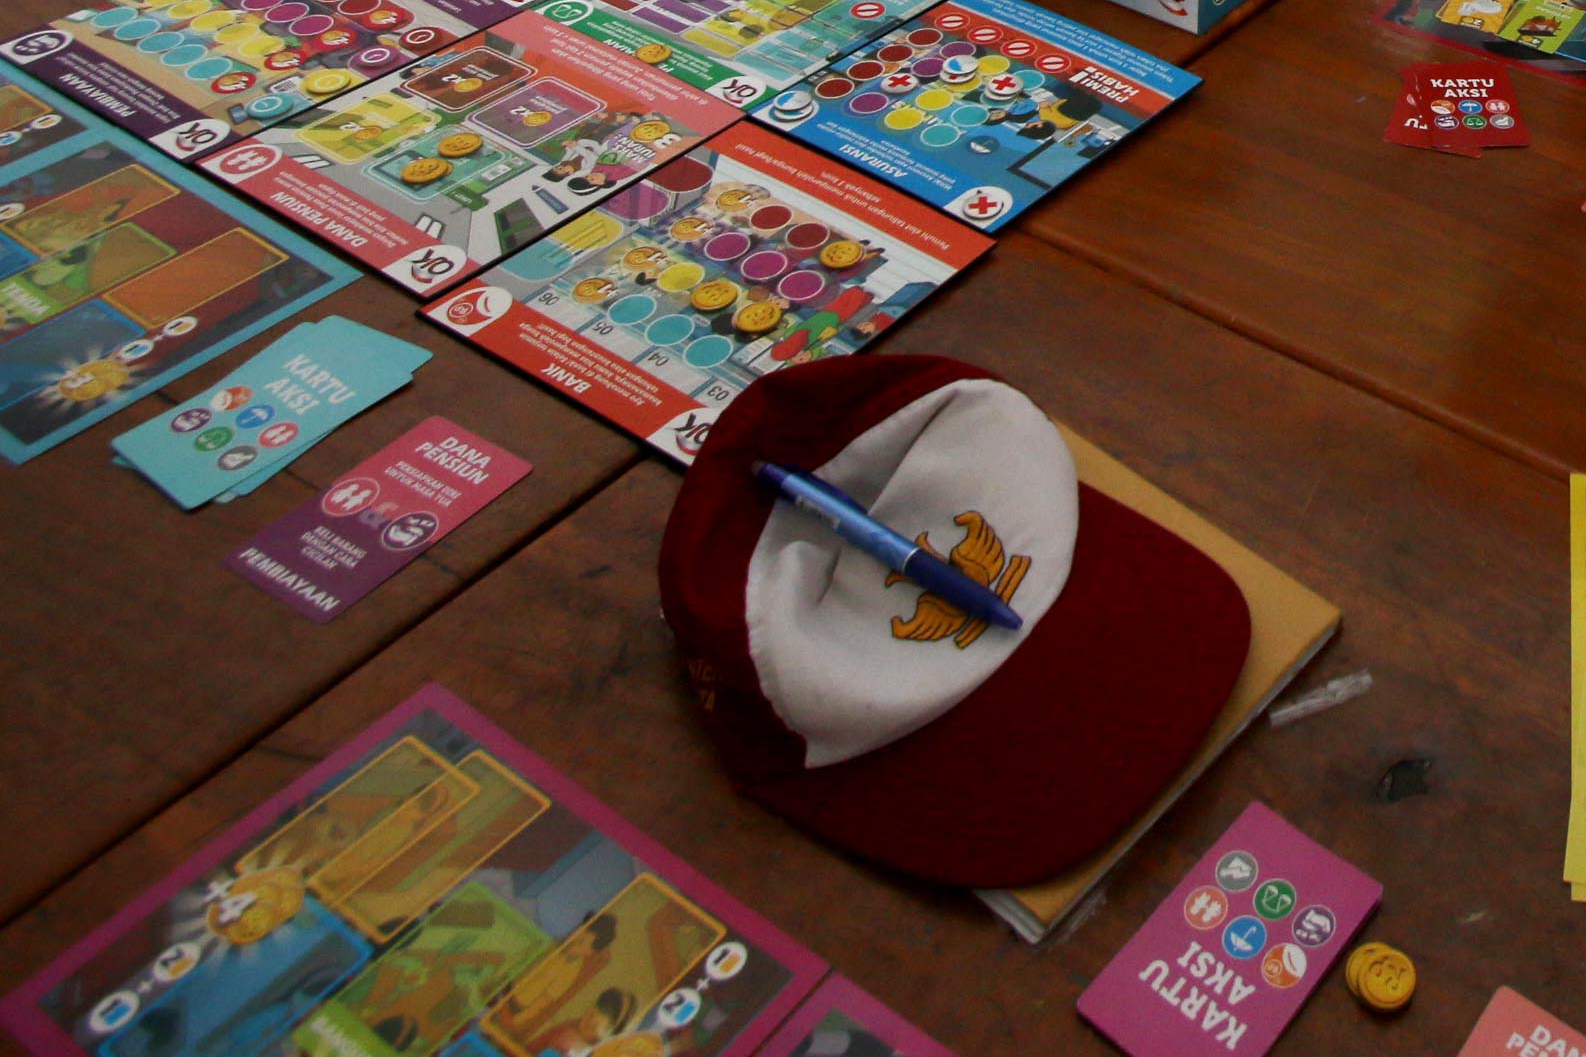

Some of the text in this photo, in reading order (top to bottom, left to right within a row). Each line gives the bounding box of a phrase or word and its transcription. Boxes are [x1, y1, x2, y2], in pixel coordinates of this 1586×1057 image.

[600, 37, 677, 73] PEAIAN
[57, 71, 138, 117] PEMBIAYAAN
[717, 77, 762, 99] OJK
[1077, 76, 1133, 104] PREMI
[1430, 78, 1495, 88] KARTU
[1444, 88, 1489, 98] AKSI
[173, 120, 222, 147] OJK
[648, 131, 685, 150] 3
[836, 142, 909, 179] ASURANSI
[267, 189, 371, 248] DANA PENSIUN
[405, 247, 460, 278] OJK
[3, 279, 51, 317] TENDA
[589, 319, 616, 336] 05
[644, 350, 672, 367] 04
[284, 353, 353, 408] KARTU
[538, 360, 594, 394] BANK
[703, 383, 733, 402] 03
[265, 375, 323, 417] AKSI
[411, 440, 491, 486] PENSIUN
[437, 435, 496, 469] DANA
[297, 543, 341, 571] CICILAN
[232, 546, 345, 613] PEMBIAYAAN
[1177, 941, 1257, 999] AKSI
[1139, 959, 1249, 1050] KARTU
